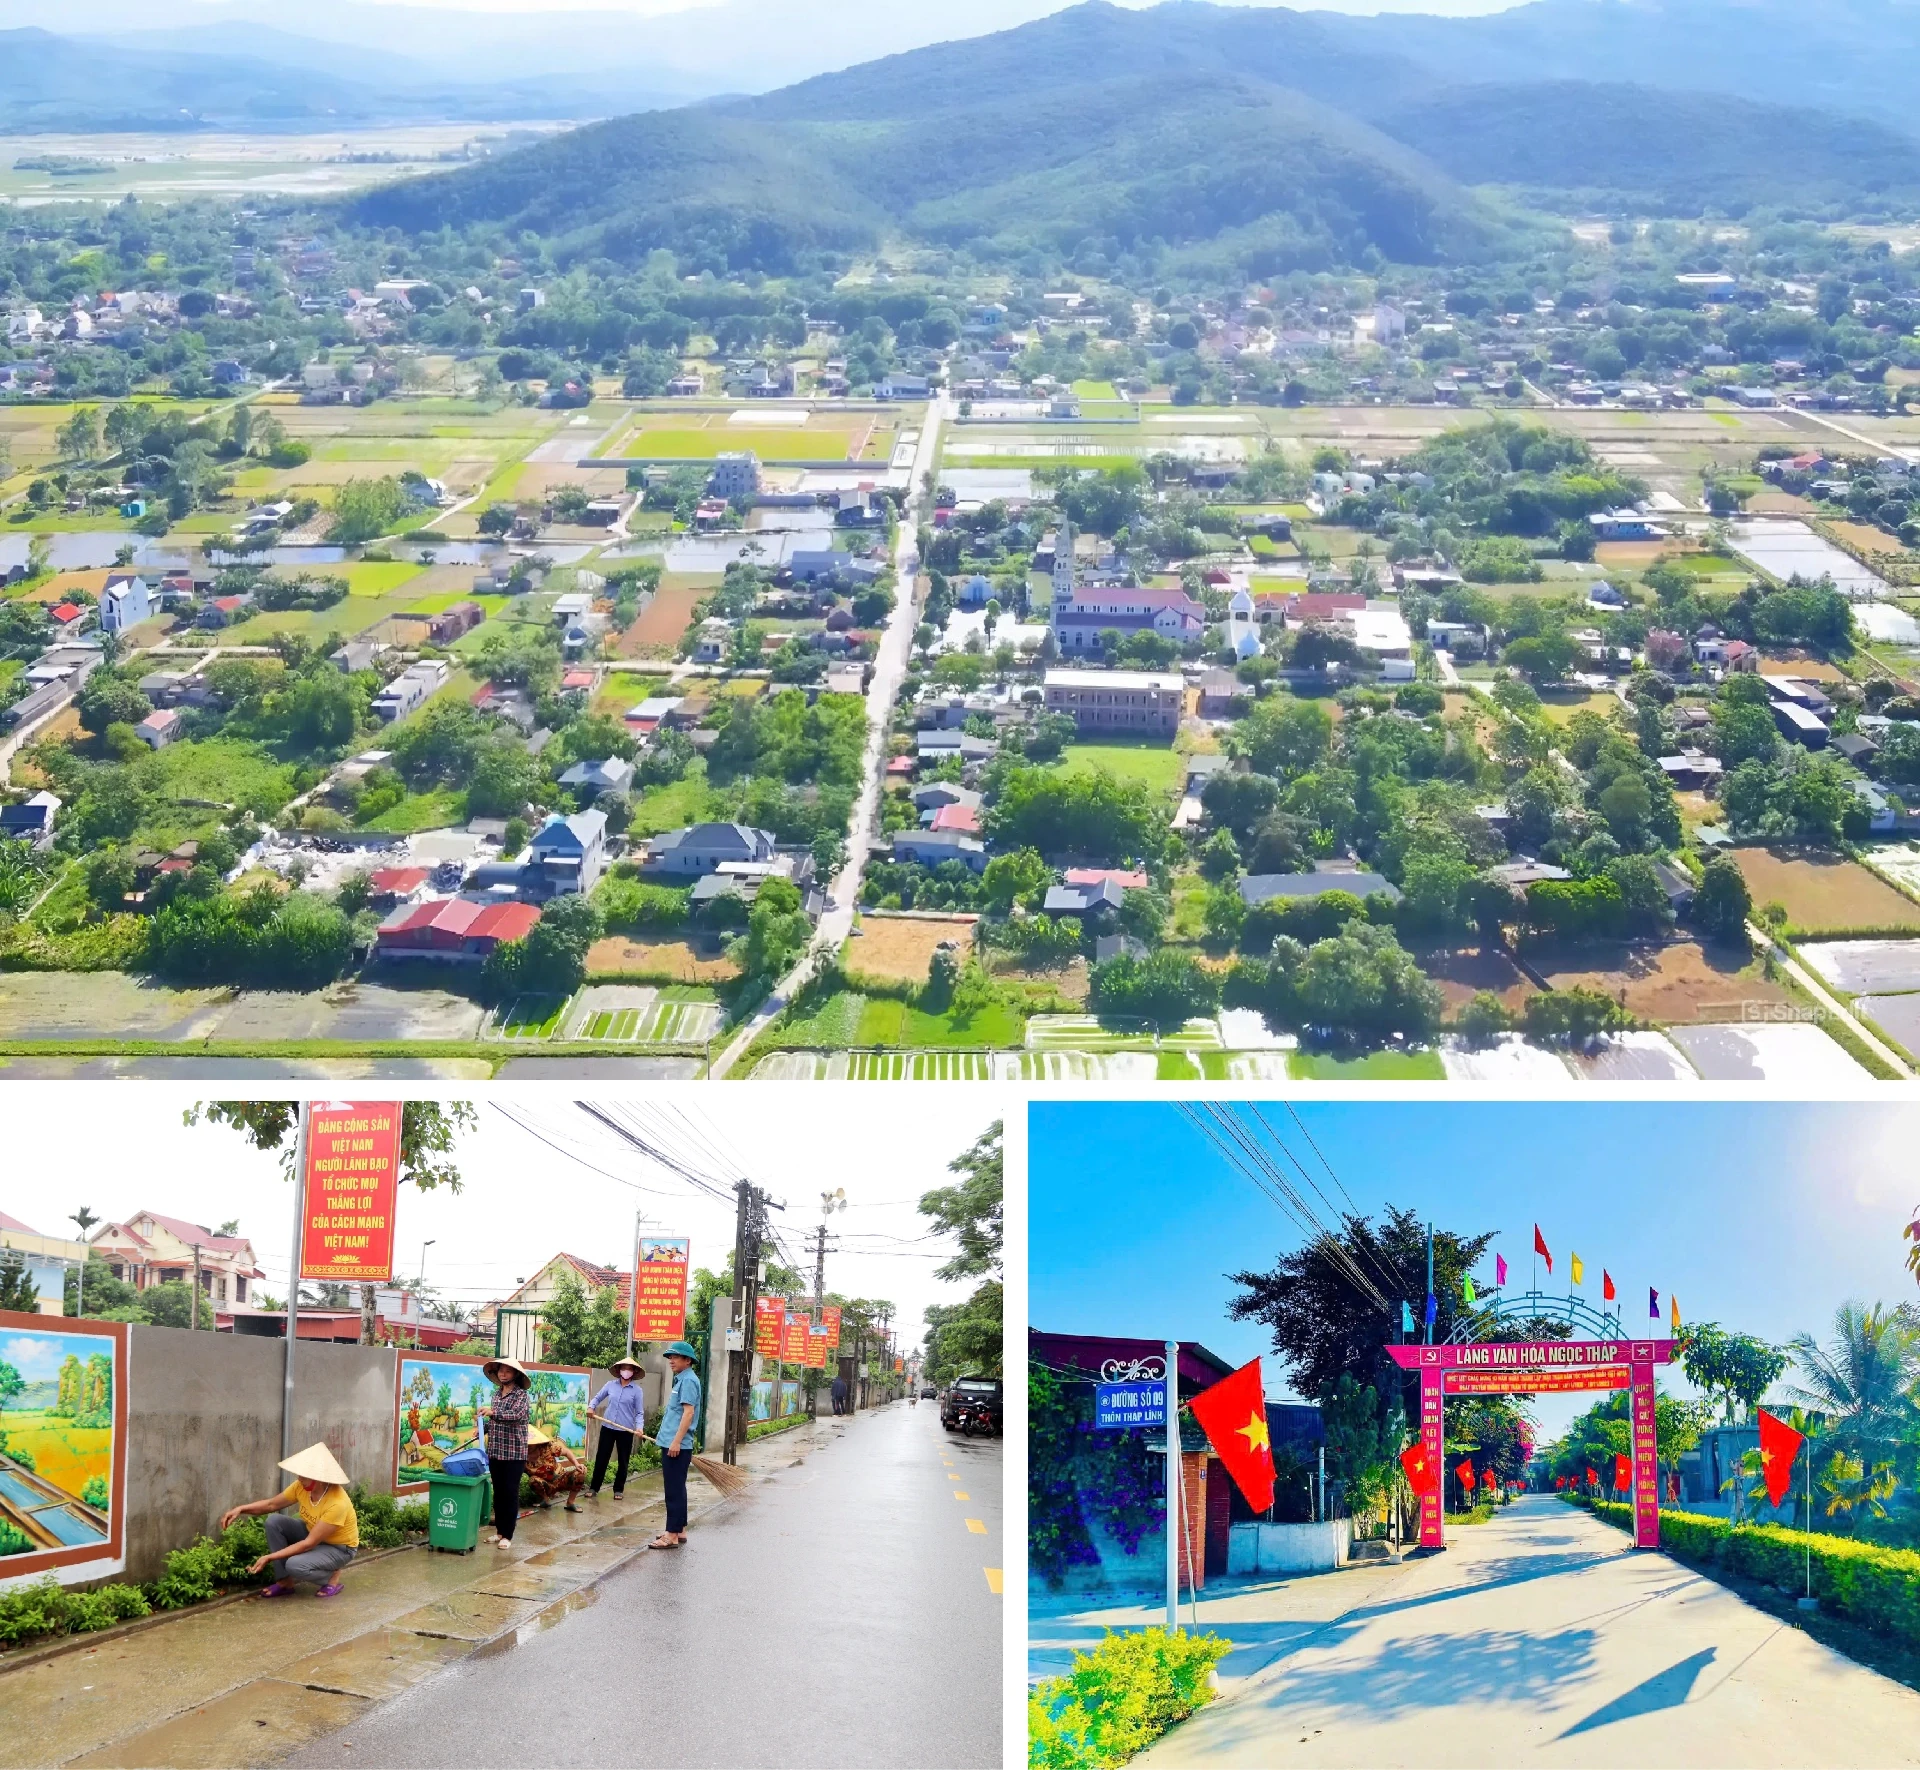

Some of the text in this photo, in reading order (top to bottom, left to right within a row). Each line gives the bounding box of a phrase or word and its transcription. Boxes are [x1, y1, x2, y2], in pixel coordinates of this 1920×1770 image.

[318, 1115, 391, 1135] ĐẢNG CỘNG SẢN
[332, 1139, 374, 1155] VIỆT NAM
[315, 1157, 388, 1173] NGƯỜI LÃNH ĐẠO
[322, 1174, 378, 1192] TỔ CHỨC MỌI
[327, 1193, 372, 1212] THẮNG LỢI
[312, 1213, 385, 1231] CỦA CÁCH MẠNG
[324, 1234, 369, 1251] VIỆT NAM!
[1456, 1342, 1618, 1365] LÀNG VĂN HÓA NGỌC THÁP
[1111, 1386, 1164, 1408] ĐƯỜNG SỐ 09
[1424, 1400, 1437, 1410] DÂN
[1101, 1411, 1121, 1423] THÔN
[1123, 1411, 1142, 1422] THÁP
